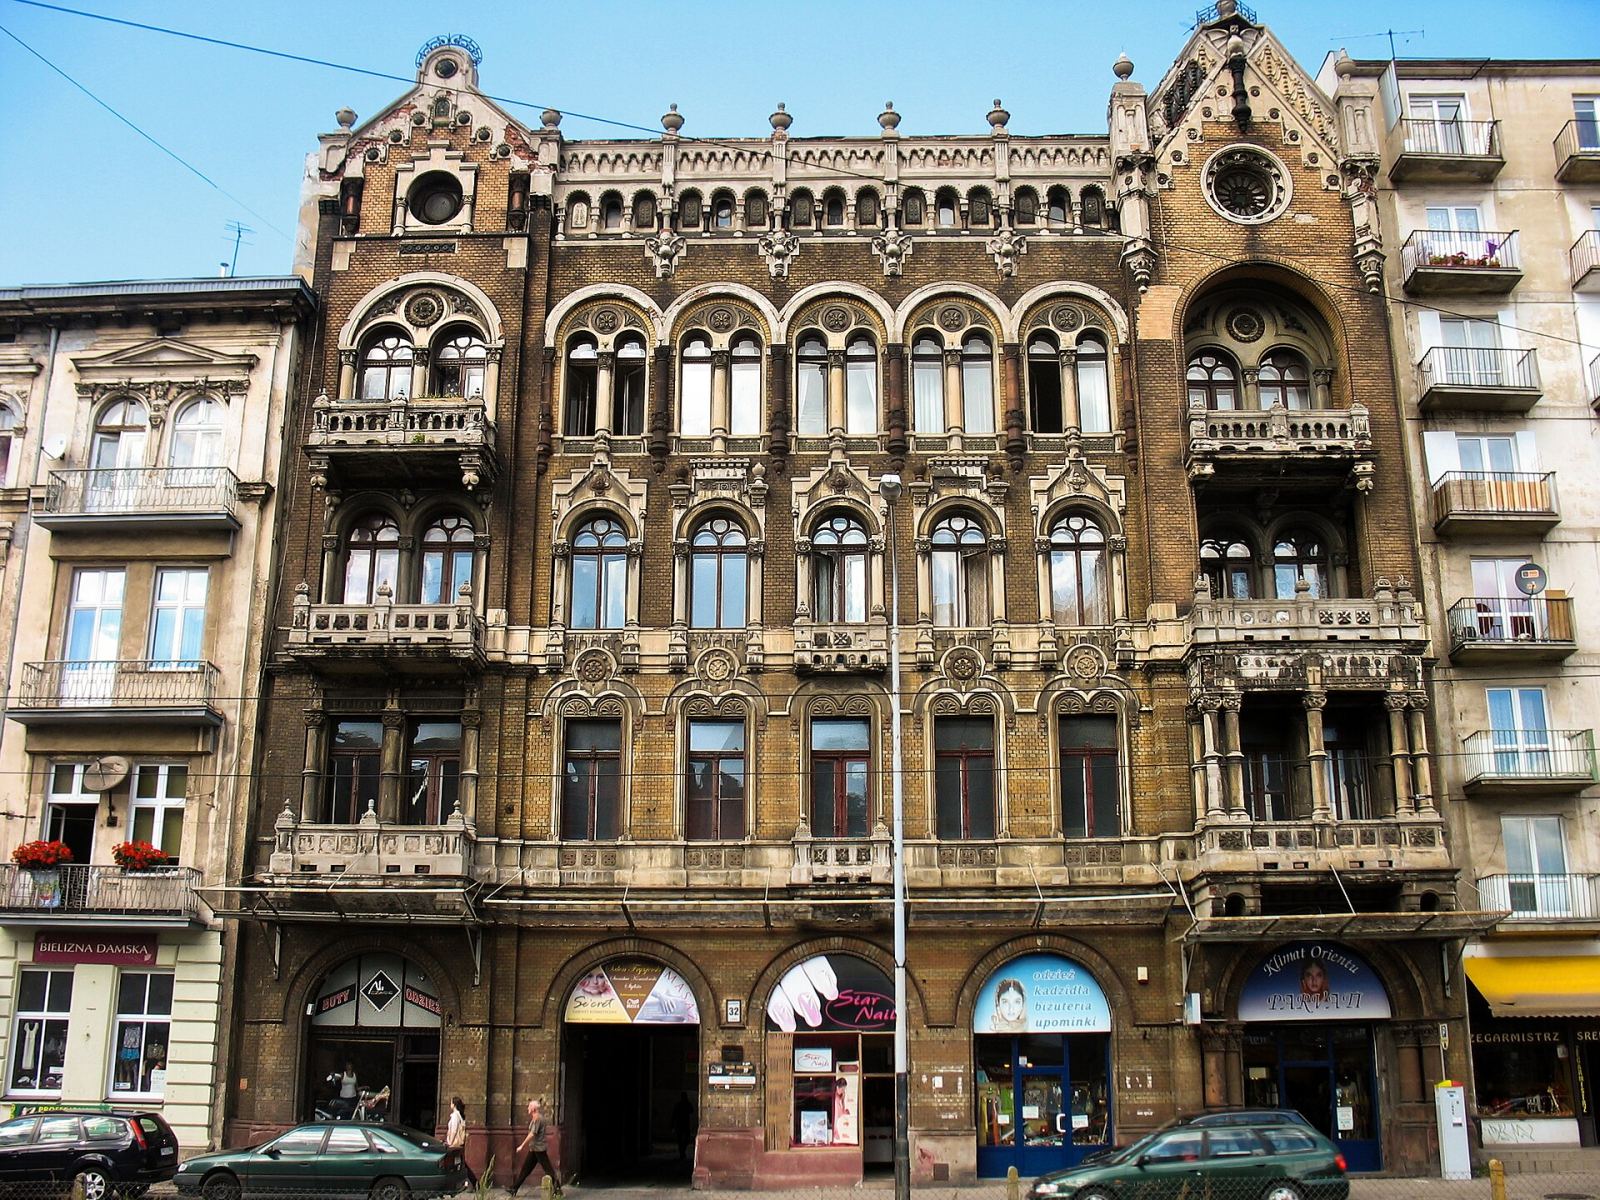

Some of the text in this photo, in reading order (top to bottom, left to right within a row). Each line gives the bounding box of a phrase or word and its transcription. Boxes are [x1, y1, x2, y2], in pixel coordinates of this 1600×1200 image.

[40, 943, 148, 954] BIELIZNA DAMSKA
[1263, 945, 1360, 977] Klimat Orientu
[322, 989, 350, 1011] BUTY
[833, 989, 880, 1008] Star
[728, 1006, 739, 1016] 32
[855, 1005, 897, 1023] Nail
[1035, 1016, 1097, 1030] upominki
[1471, 1032, 1560, 1043] ZEGARMISTRZ
[1576, 1031, 1600, 1041] SRE
